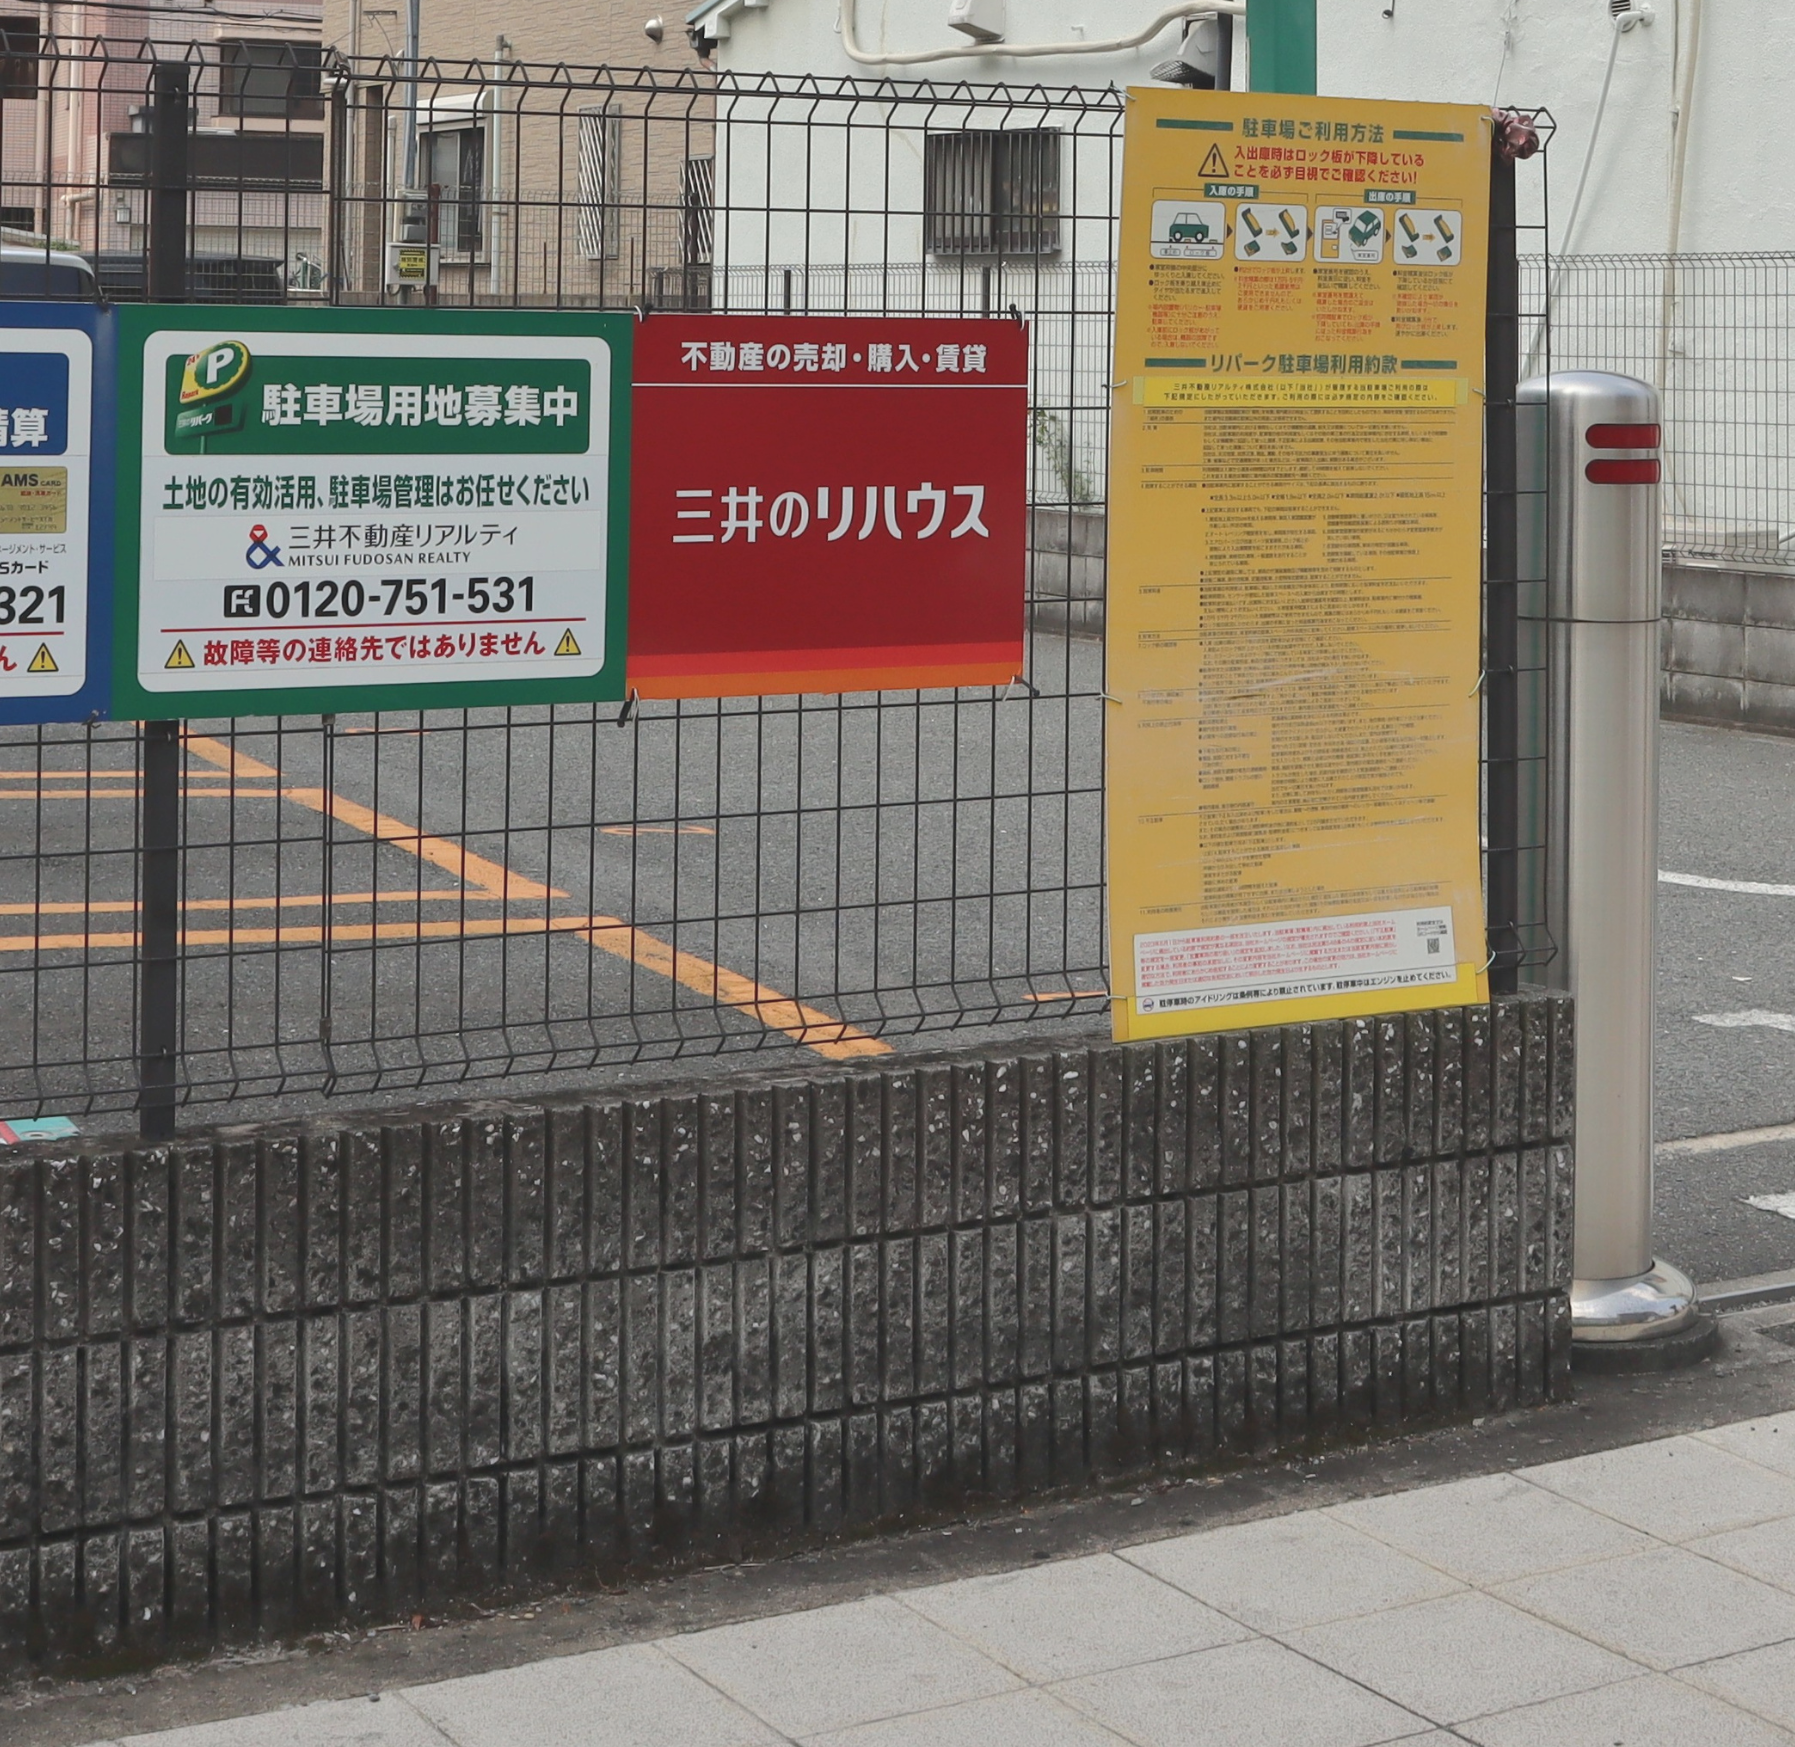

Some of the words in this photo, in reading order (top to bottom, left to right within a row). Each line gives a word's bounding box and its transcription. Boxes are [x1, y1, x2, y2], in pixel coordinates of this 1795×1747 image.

[1242, 118, 1385, 144] 駐車場ご利用方法
[1234, 145, 1425, 167] 入出庫時はロック板が下降している
[1233, 164, 1417, 184] ことを必ず目視でご確認ください!
[1209, 186, 1254, 197] 入庫の手順
[1368, 191, 1411, 203] 出庫の手順
[681, 341, 987, 373] 不動産の売却・購入・賃貸
[1211, 353, 1398, 374] リパーク駐車場利用約款
[261, 383, 579, 427] 駐車場用地募集中
[1, 473, 39, 487] AMS
[163, 475, 589, 511] 土地の有効活用、駐車場管理はお任せください
[672, 482, 989, 543] 三井のリハウス
[288, 524, 518, 551] 三井不動産リアルティ
[288, 554, 340, 567] MITSUI
[343, 552, 415, 566] FUDOSAN
[417, 551, 471, 565] REALTY
[266, 576, 535, 619] 0120-751-531
[203, 631, 546, 667] 故障等の連絡先ではありません
